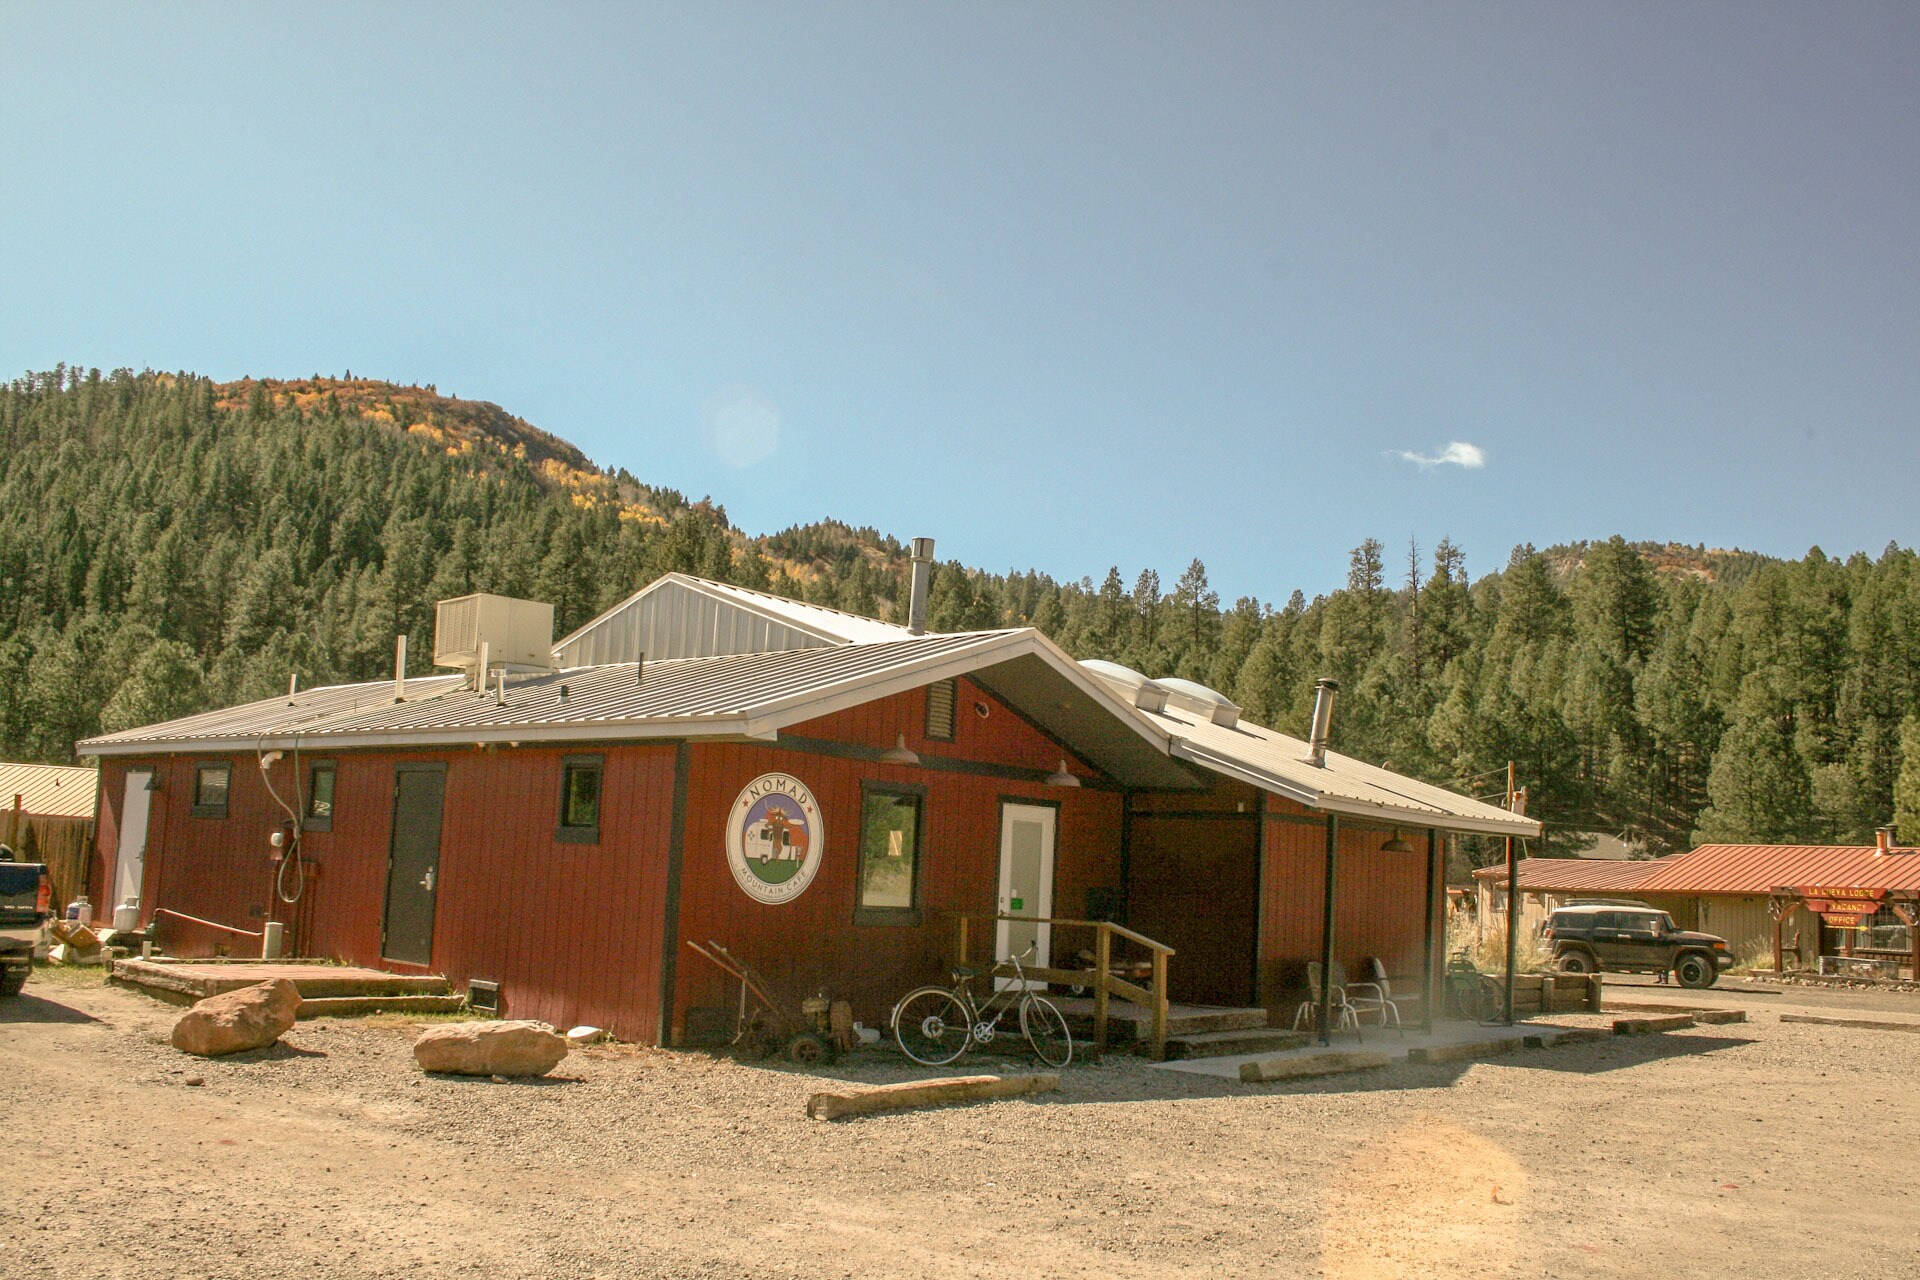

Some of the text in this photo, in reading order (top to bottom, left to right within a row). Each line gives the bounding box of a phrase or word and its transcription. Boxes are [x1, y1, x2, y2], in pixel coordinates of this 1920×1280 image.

[750, 779, 807, 804] NOMAD
[741, 867, 783, 895] MOUNTAIN
[1822, 888, 1846, 897] CUEVA
[1850, 889, 1874, 897] LODGE
[1829, 916, 1855, 925] OFFICE
